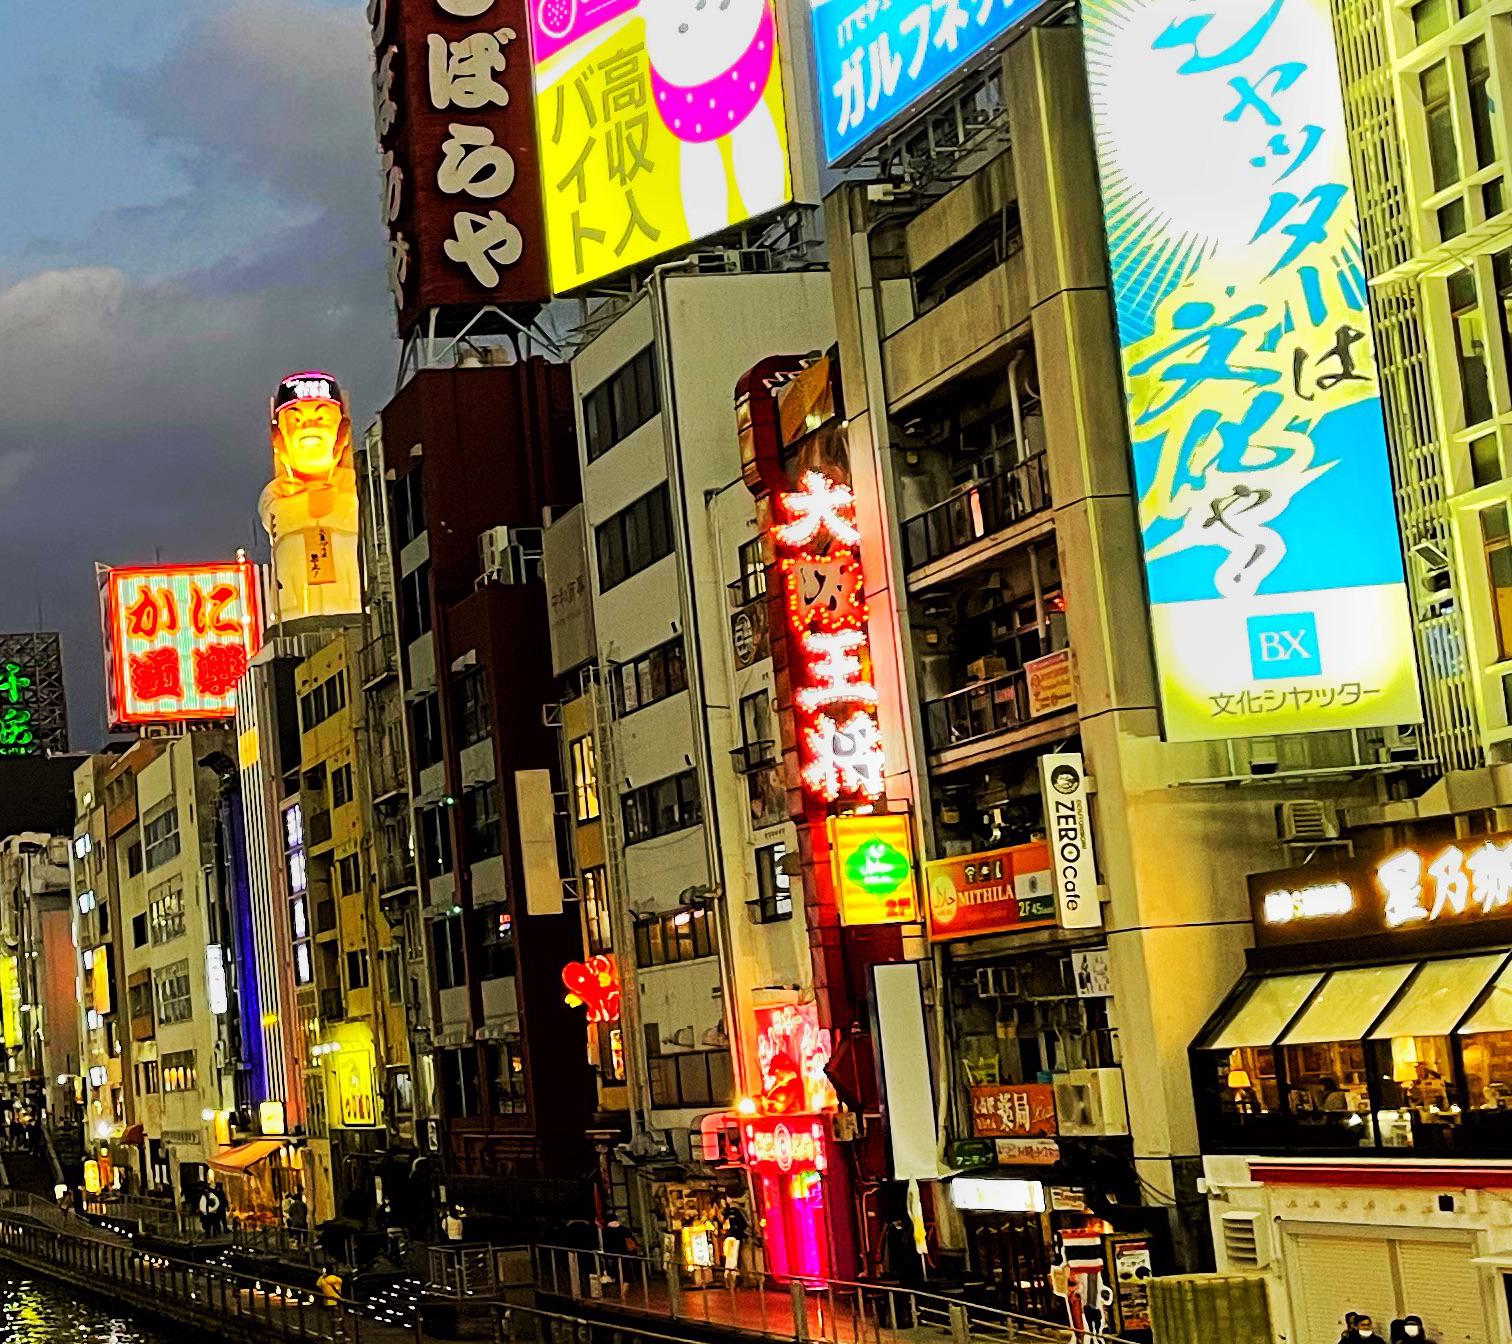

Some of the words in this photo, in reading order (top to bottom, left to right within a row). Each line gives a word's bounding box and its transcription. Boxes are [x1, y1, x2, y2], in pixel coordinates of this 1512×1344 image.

[551, 64, 607, 275] バイト
[597, 41, 661, 258] 高収入
[125, 582, 243, 641] かに
[1258, 628, 1312, 662] BX
[1055, 799, 1081, 864] ZERO
[885, 897, 911, 918] 2F
[957, 884, 1015, 907] MITHILA
[1061, 865, 1080, 912] cafe
